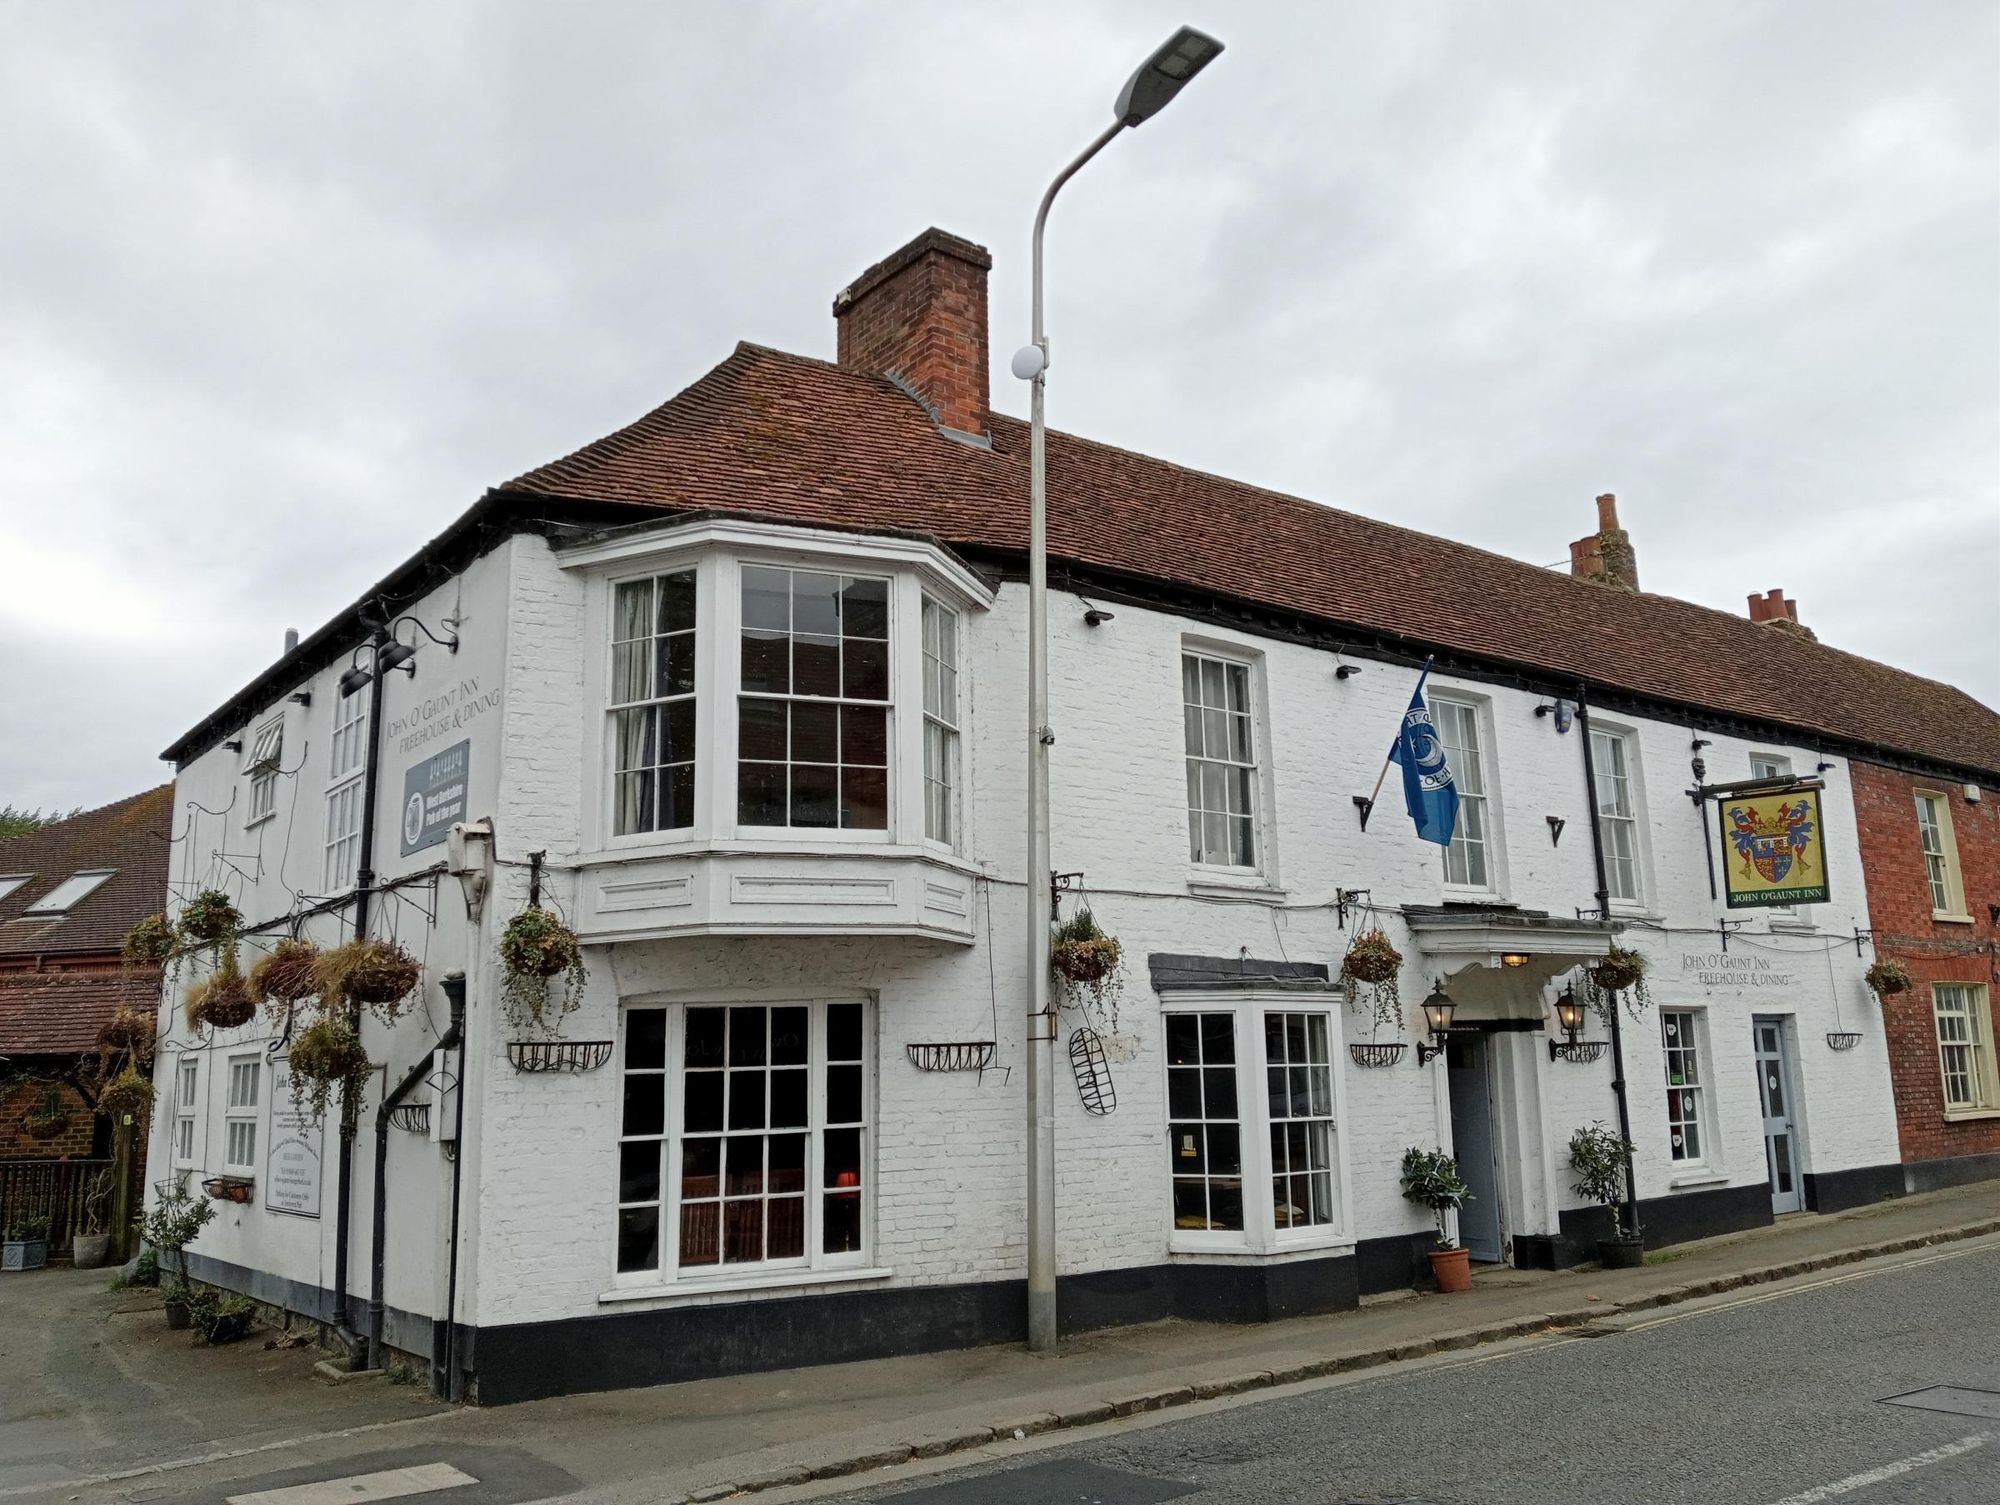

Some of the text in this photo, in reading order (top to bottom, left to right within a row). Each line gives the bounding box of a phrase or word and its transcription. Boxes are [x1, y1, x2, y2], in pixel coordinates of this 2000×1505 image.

[460, 676, 480, 701] INN
[399, 688, 500, 754] FREEHOUSE & DINING
[1733, 888, 1822, 903] JOHN O'GAUNT INN
[1682, 953, 1706, 971] JOHN
[1754, 956, 1770, 970] INN
[1699, 972, 1789, 987] FREEHOUSE & DINING
